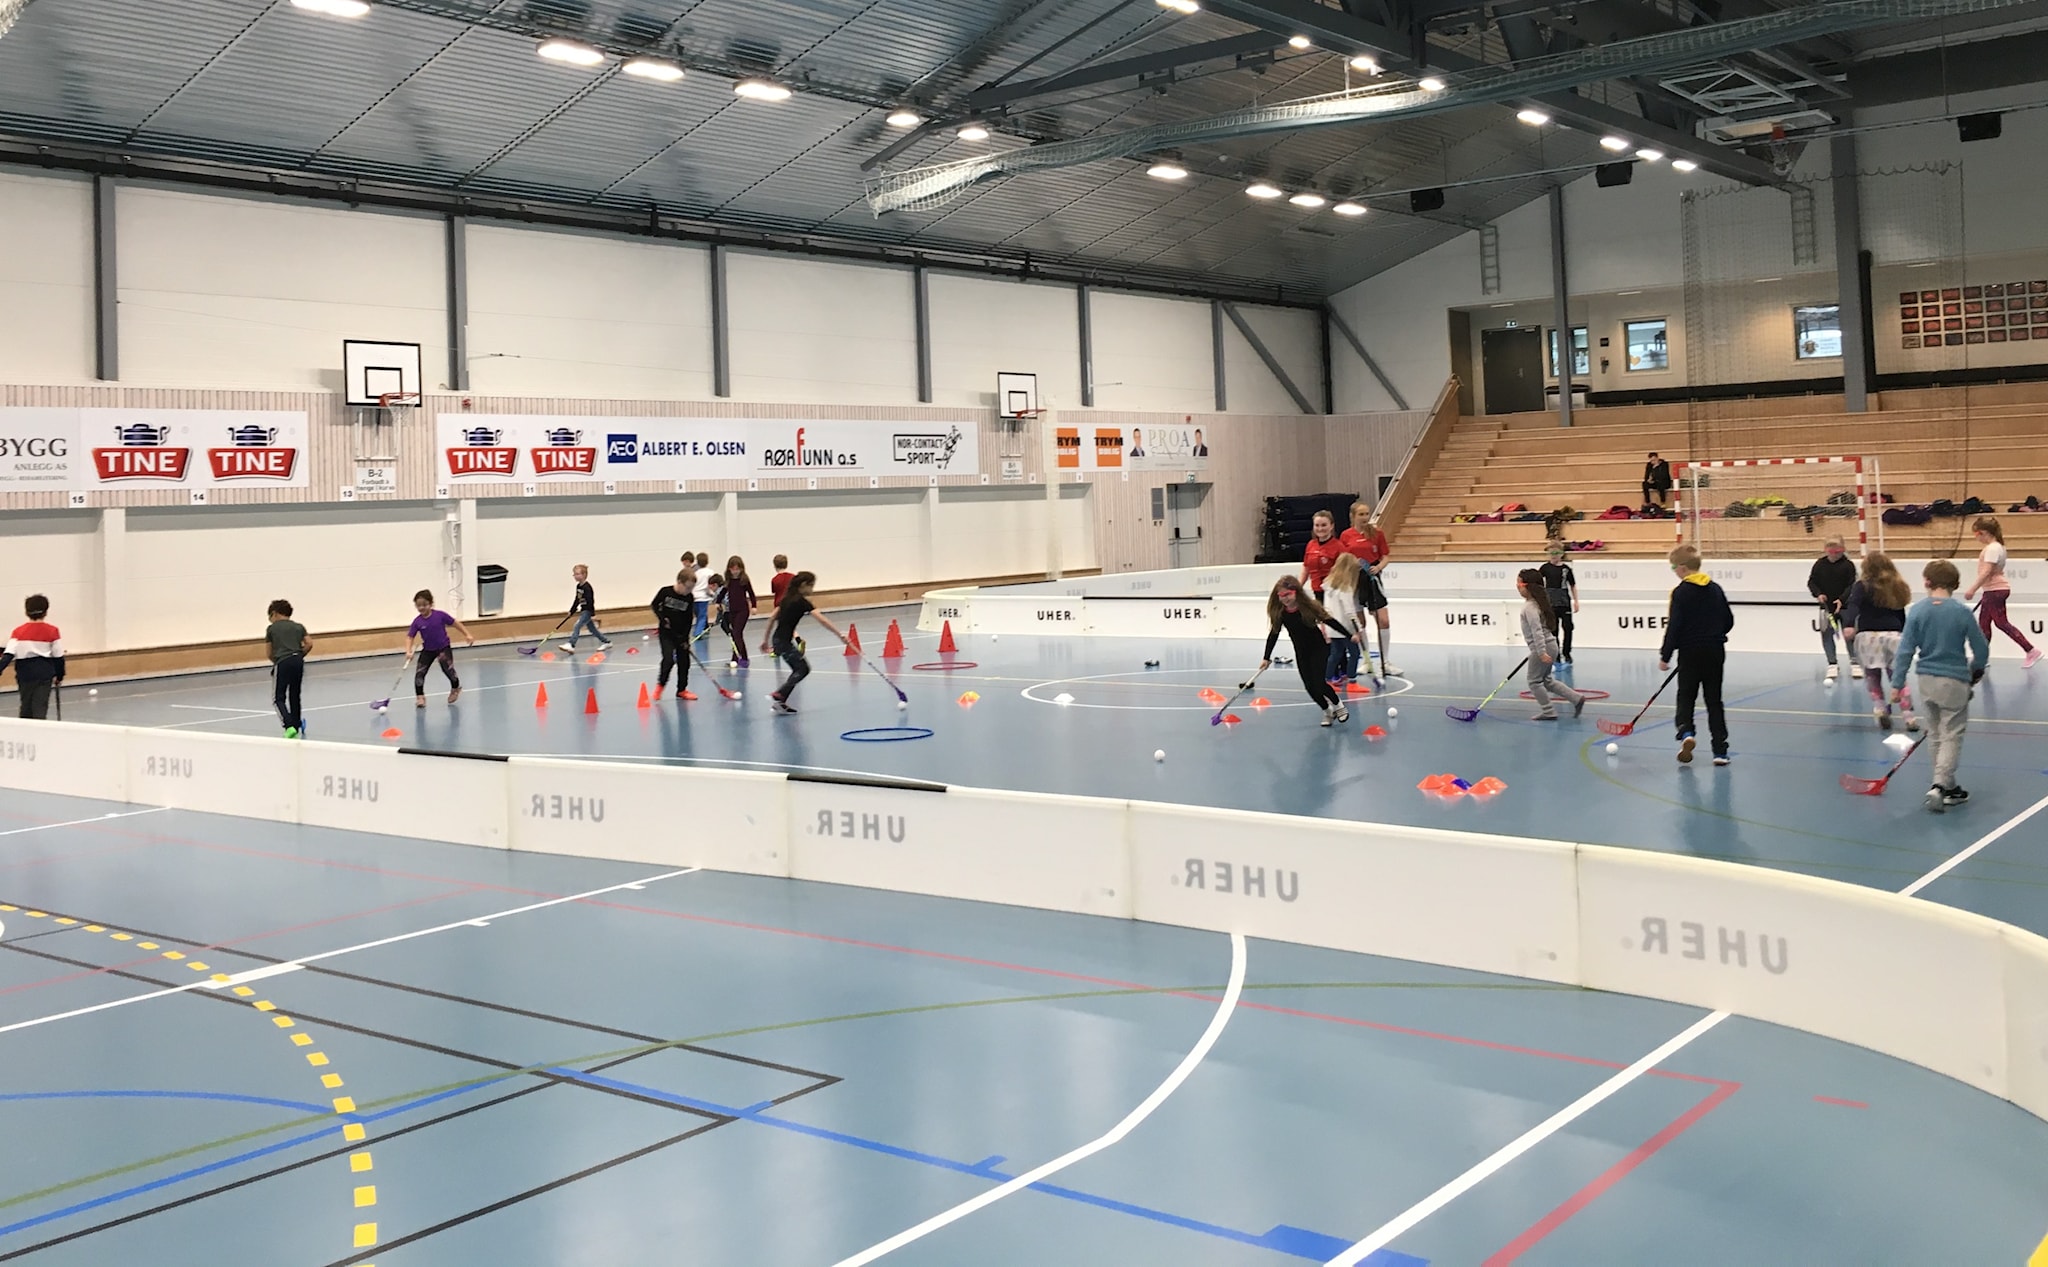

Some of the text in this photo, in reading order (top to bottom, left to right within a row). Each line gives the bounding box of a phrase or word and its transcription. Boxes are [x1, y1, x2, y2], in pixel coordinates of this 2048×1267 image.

[897, 438, 943, 449] NOR-CONTACT
[1056, 436, 1081, 447] RYM
[1094, 436, 1124, 447] TRYM
[1148, 428, 1191, 448] PROA
[608, 440, 638, 457] AEO
[642, 441, 746, 456] ALBERT E. OLSEN
[101, 451, 178, 473] TINE
[215, 451, 286, 472] TINE
[452, 450, 509, 469] TINE
[536, 450, 589, 468] TINE
[907, 452, 936, 465] SPORT
[13, 462, 68, 471] ANLEGG AS
[367, 469, 384, 478] B-2
[71, 495, 85, 504] 15
[193, 493, 205, 501] 14
[343, 490, 353, 498] 13
